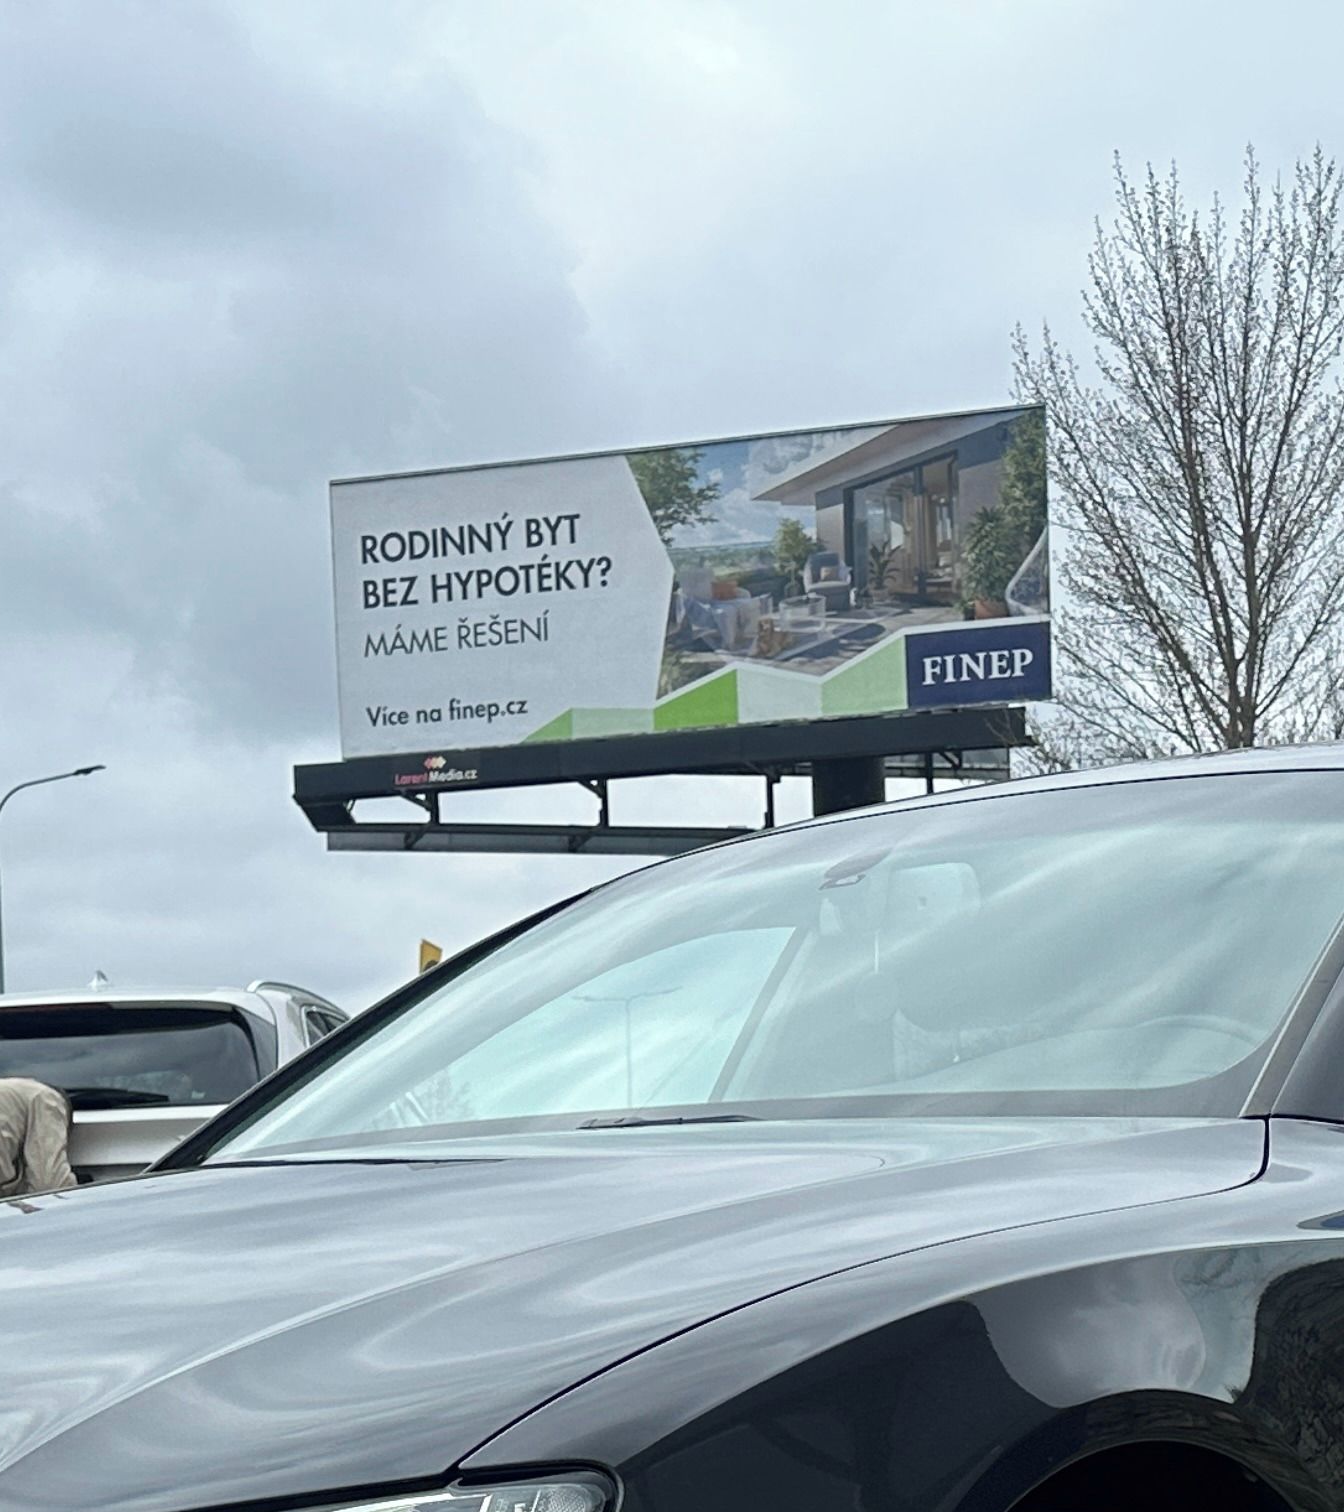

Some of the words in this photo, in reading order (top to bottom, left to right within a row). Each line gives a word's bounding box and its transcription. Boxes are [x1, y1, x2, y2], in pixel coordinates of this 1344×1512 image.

[361, 512, 514, 565] RODINNÝ
[525, 513, 581, 548] BYT
[363, 576, 418, 609] BEZ
[431, 553, 612, 603] HYPOTÉKY?
[364, 623, 448, 658] MÁME
[457, 609, 550, 650] ŘEŠENÍ
[922, 648, 1034, 686] FINEP
[366, 705, 409, 727] Více
[416, 706, 442, 722] na
[449, 698, 528, 724] finep.cz
